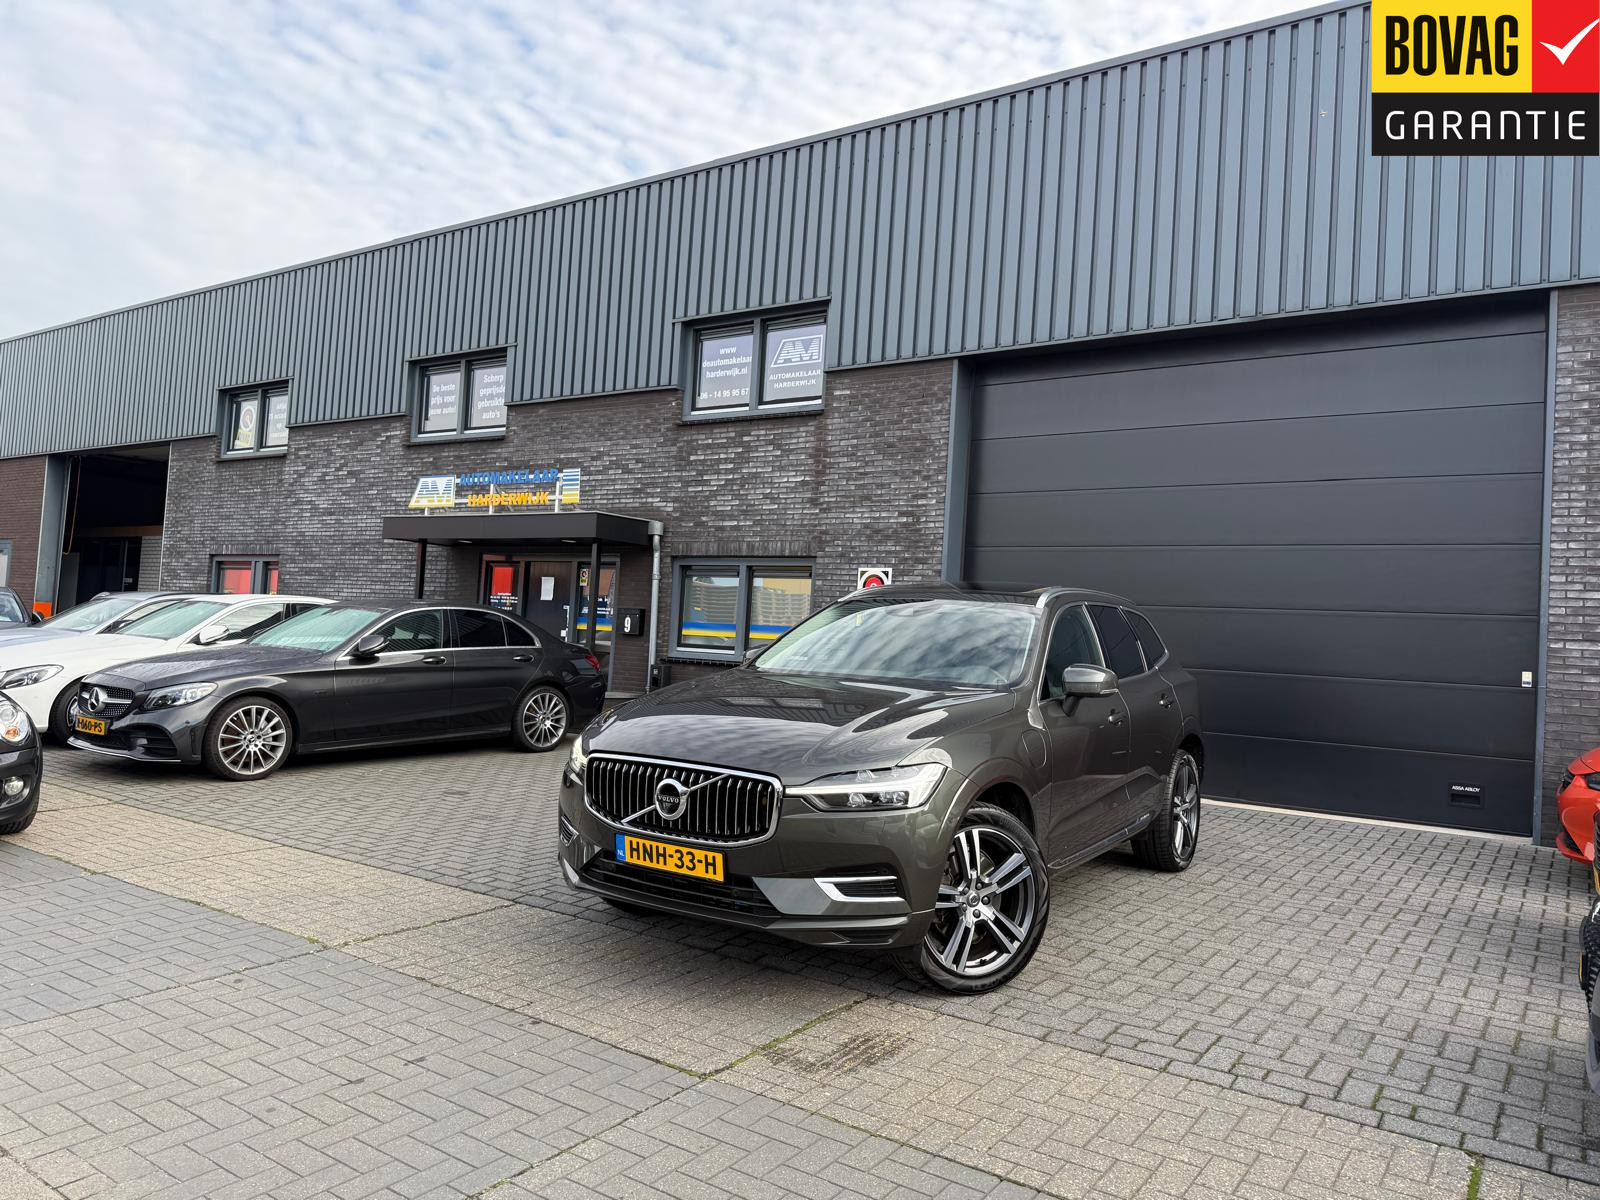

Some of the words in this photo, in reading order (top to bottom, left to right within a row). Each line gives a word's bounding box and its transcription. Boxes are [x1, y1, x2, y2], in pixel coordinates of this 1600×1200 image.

[705, 366, 748, 378] harderwijk.nl
[769, 369, 822, 380] AUTOMAKELAAR
[484, 374, 503, 383] Scherp
[773, 378, 817, 389] HARDERWIJK
[460, 468, 559, 486] AUTOMAKELAAR
[467, 491, 550, 507] HARDERWIJK
[624, 616, 631, 633] 9
[657, 795, 679, 804] VOLVO
[617, 849, 625, 857] NL
[629, 840, 717, 876] HNH-33-H
